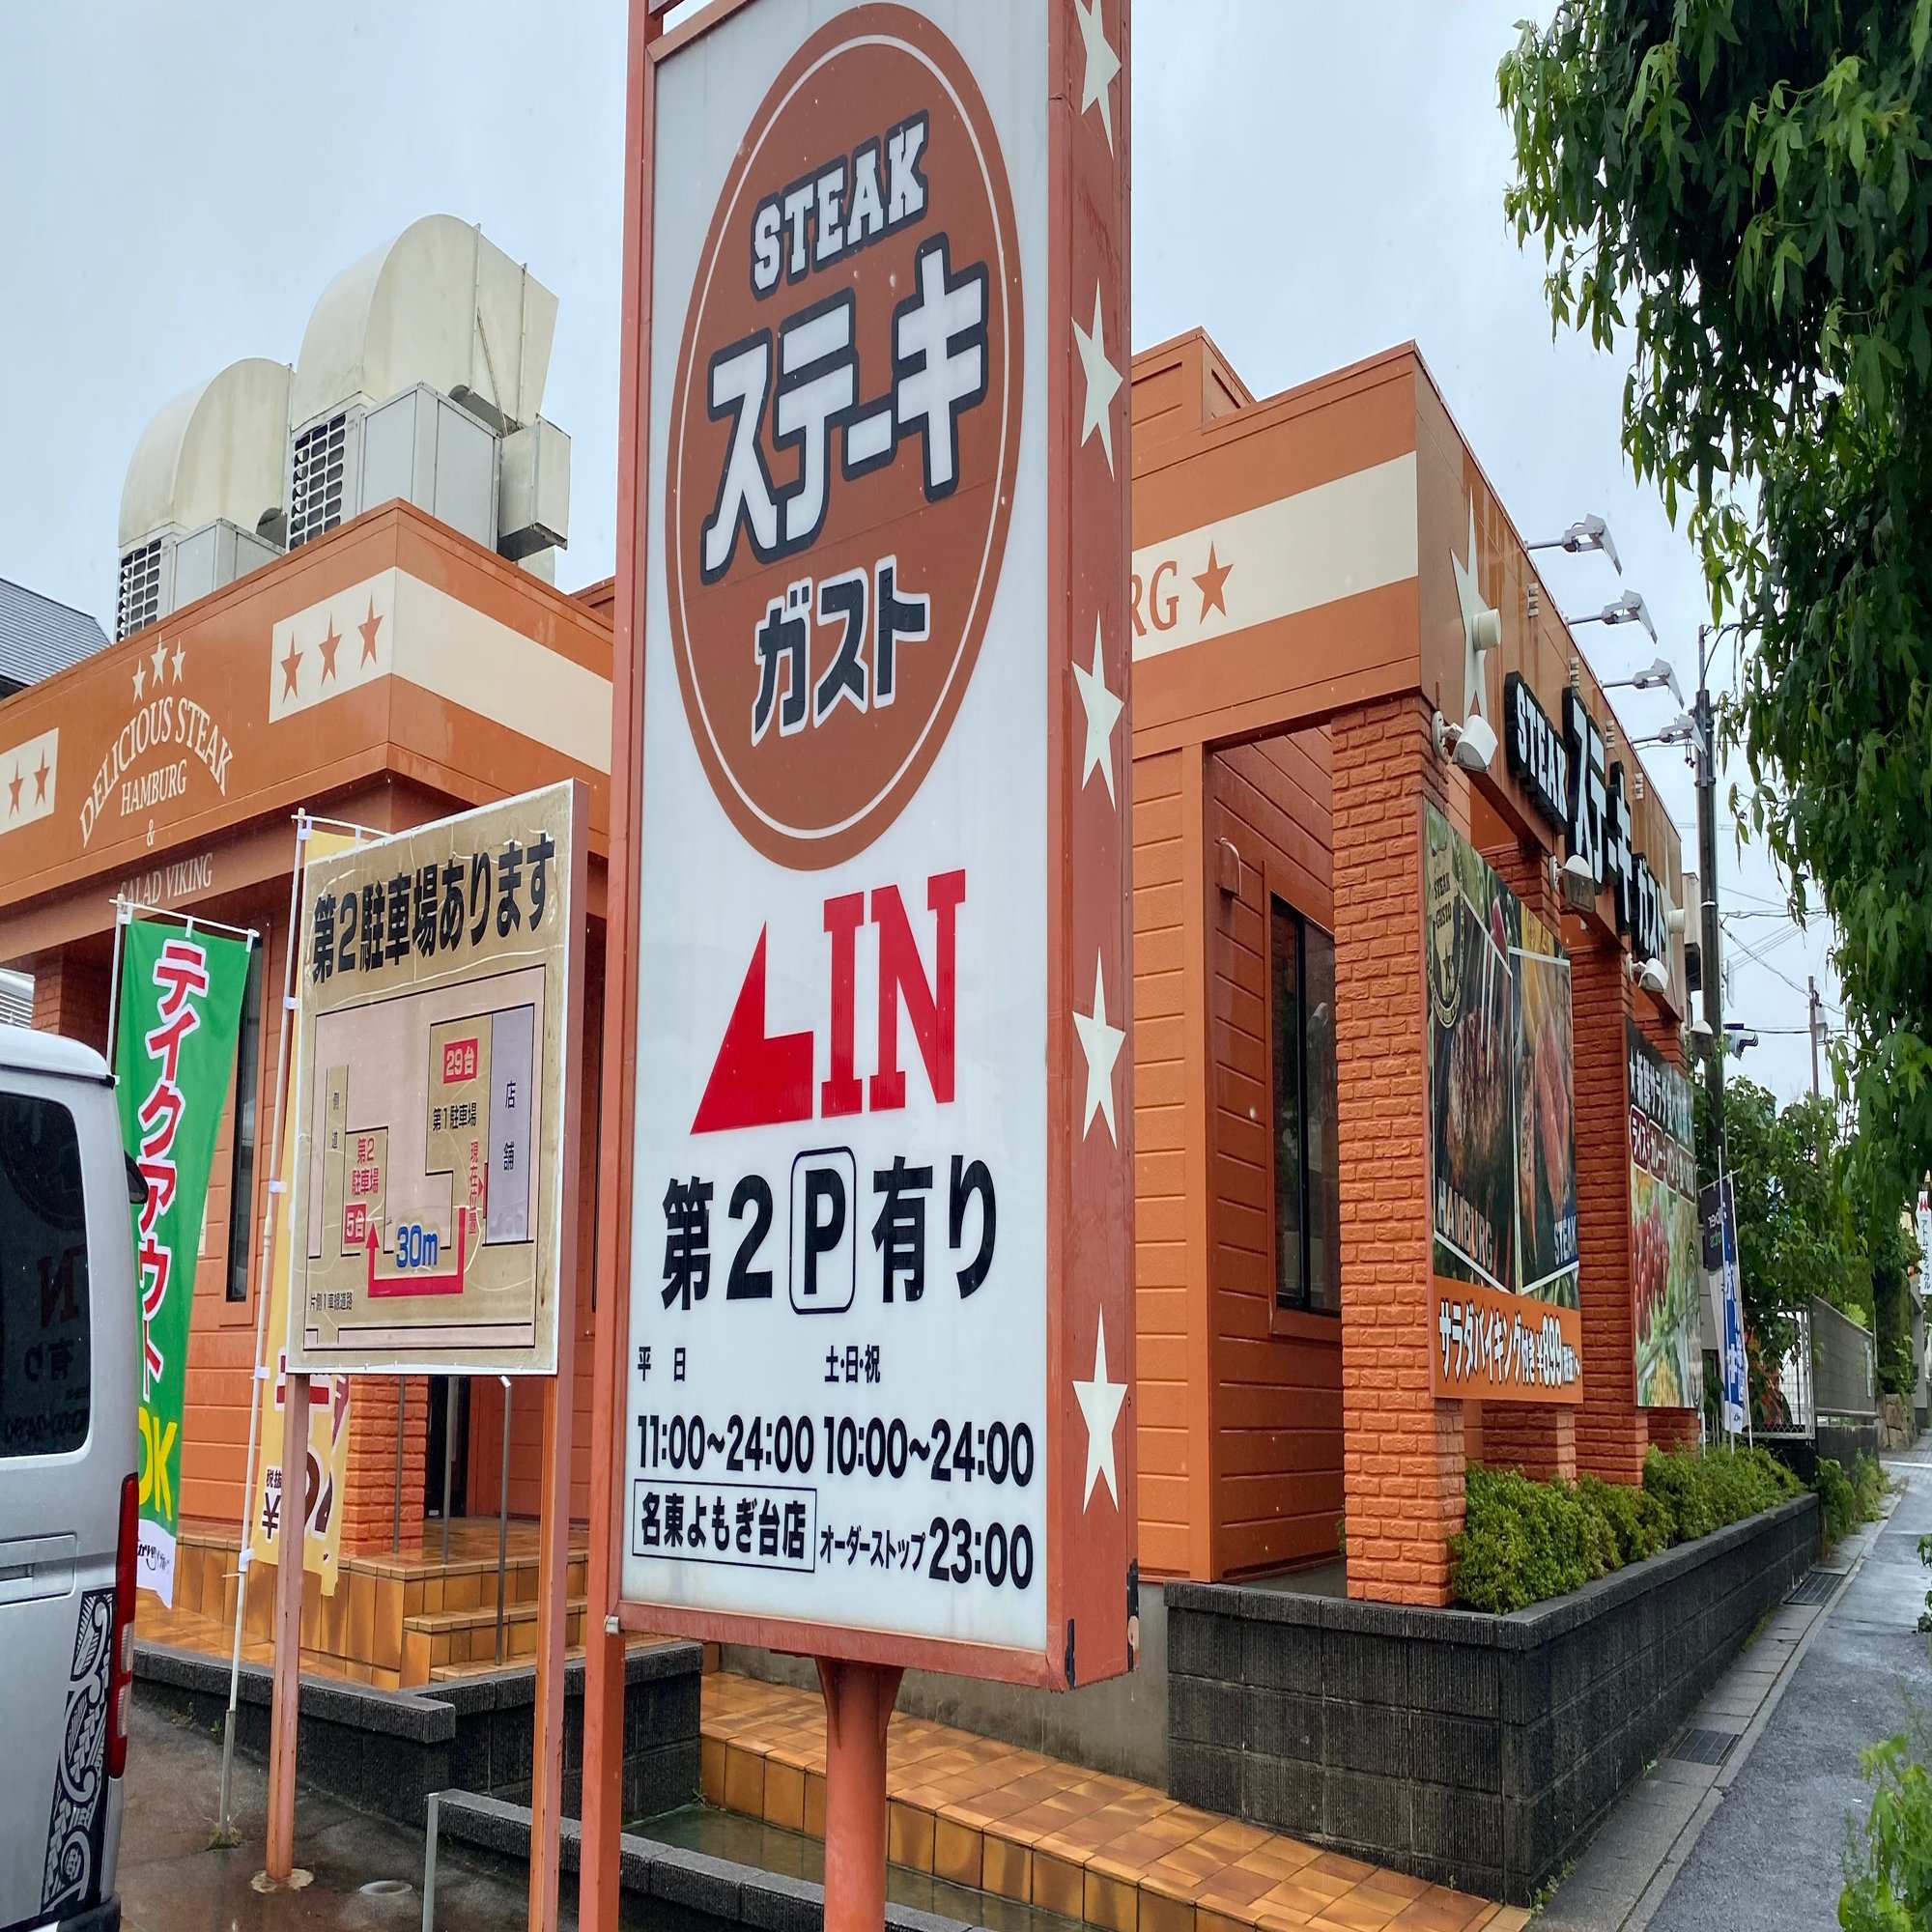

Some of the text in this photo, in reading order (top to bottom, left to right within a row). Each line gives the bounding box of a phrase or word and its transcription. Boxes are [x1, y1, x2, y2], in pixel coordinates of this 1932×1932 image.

[751, 109, 929, 301] STEAK
[700, 232, 988, 585] ステーキ
[752, 555, 929, 746] ガスト
[79, 696, 233, 849] DELICIOUS STEAK
[120, 758, 187, 816] HAMBURG
[1517, 681, 1568, 822] STEAK
[146, 819, 156, 847] &
[1573, 696, 1633, 923] ステーキ
[119, 853, 213, 913] SALAD VIKING
[313, 833, 554, 984] 第2駐車場あります
[1637, 858, 1665, 962] ガスト
[821, 869, 965, 1119] IN
[445, 1046, 474, 1076] 29台
[357, 1137, 375, 1164] 第2
[433, 1102, 477, 1131] 第1駐車場
[138, 940, 209, 1403] テイクアウト
[352, 1167, 380, 1196] 駐車場
[346, 1208, 365, 1239] 5台
[396, 1224, 438, 1268] 30m
[1438, 1177, 1493, 1271] HAMBURG
[1554, 1213, 1577, 1265] STEAK
[640, 1492, 807, 1560] 名東よもぎ台店
[820, 1516, 1035, 1590] オーダーストップ 23:00
